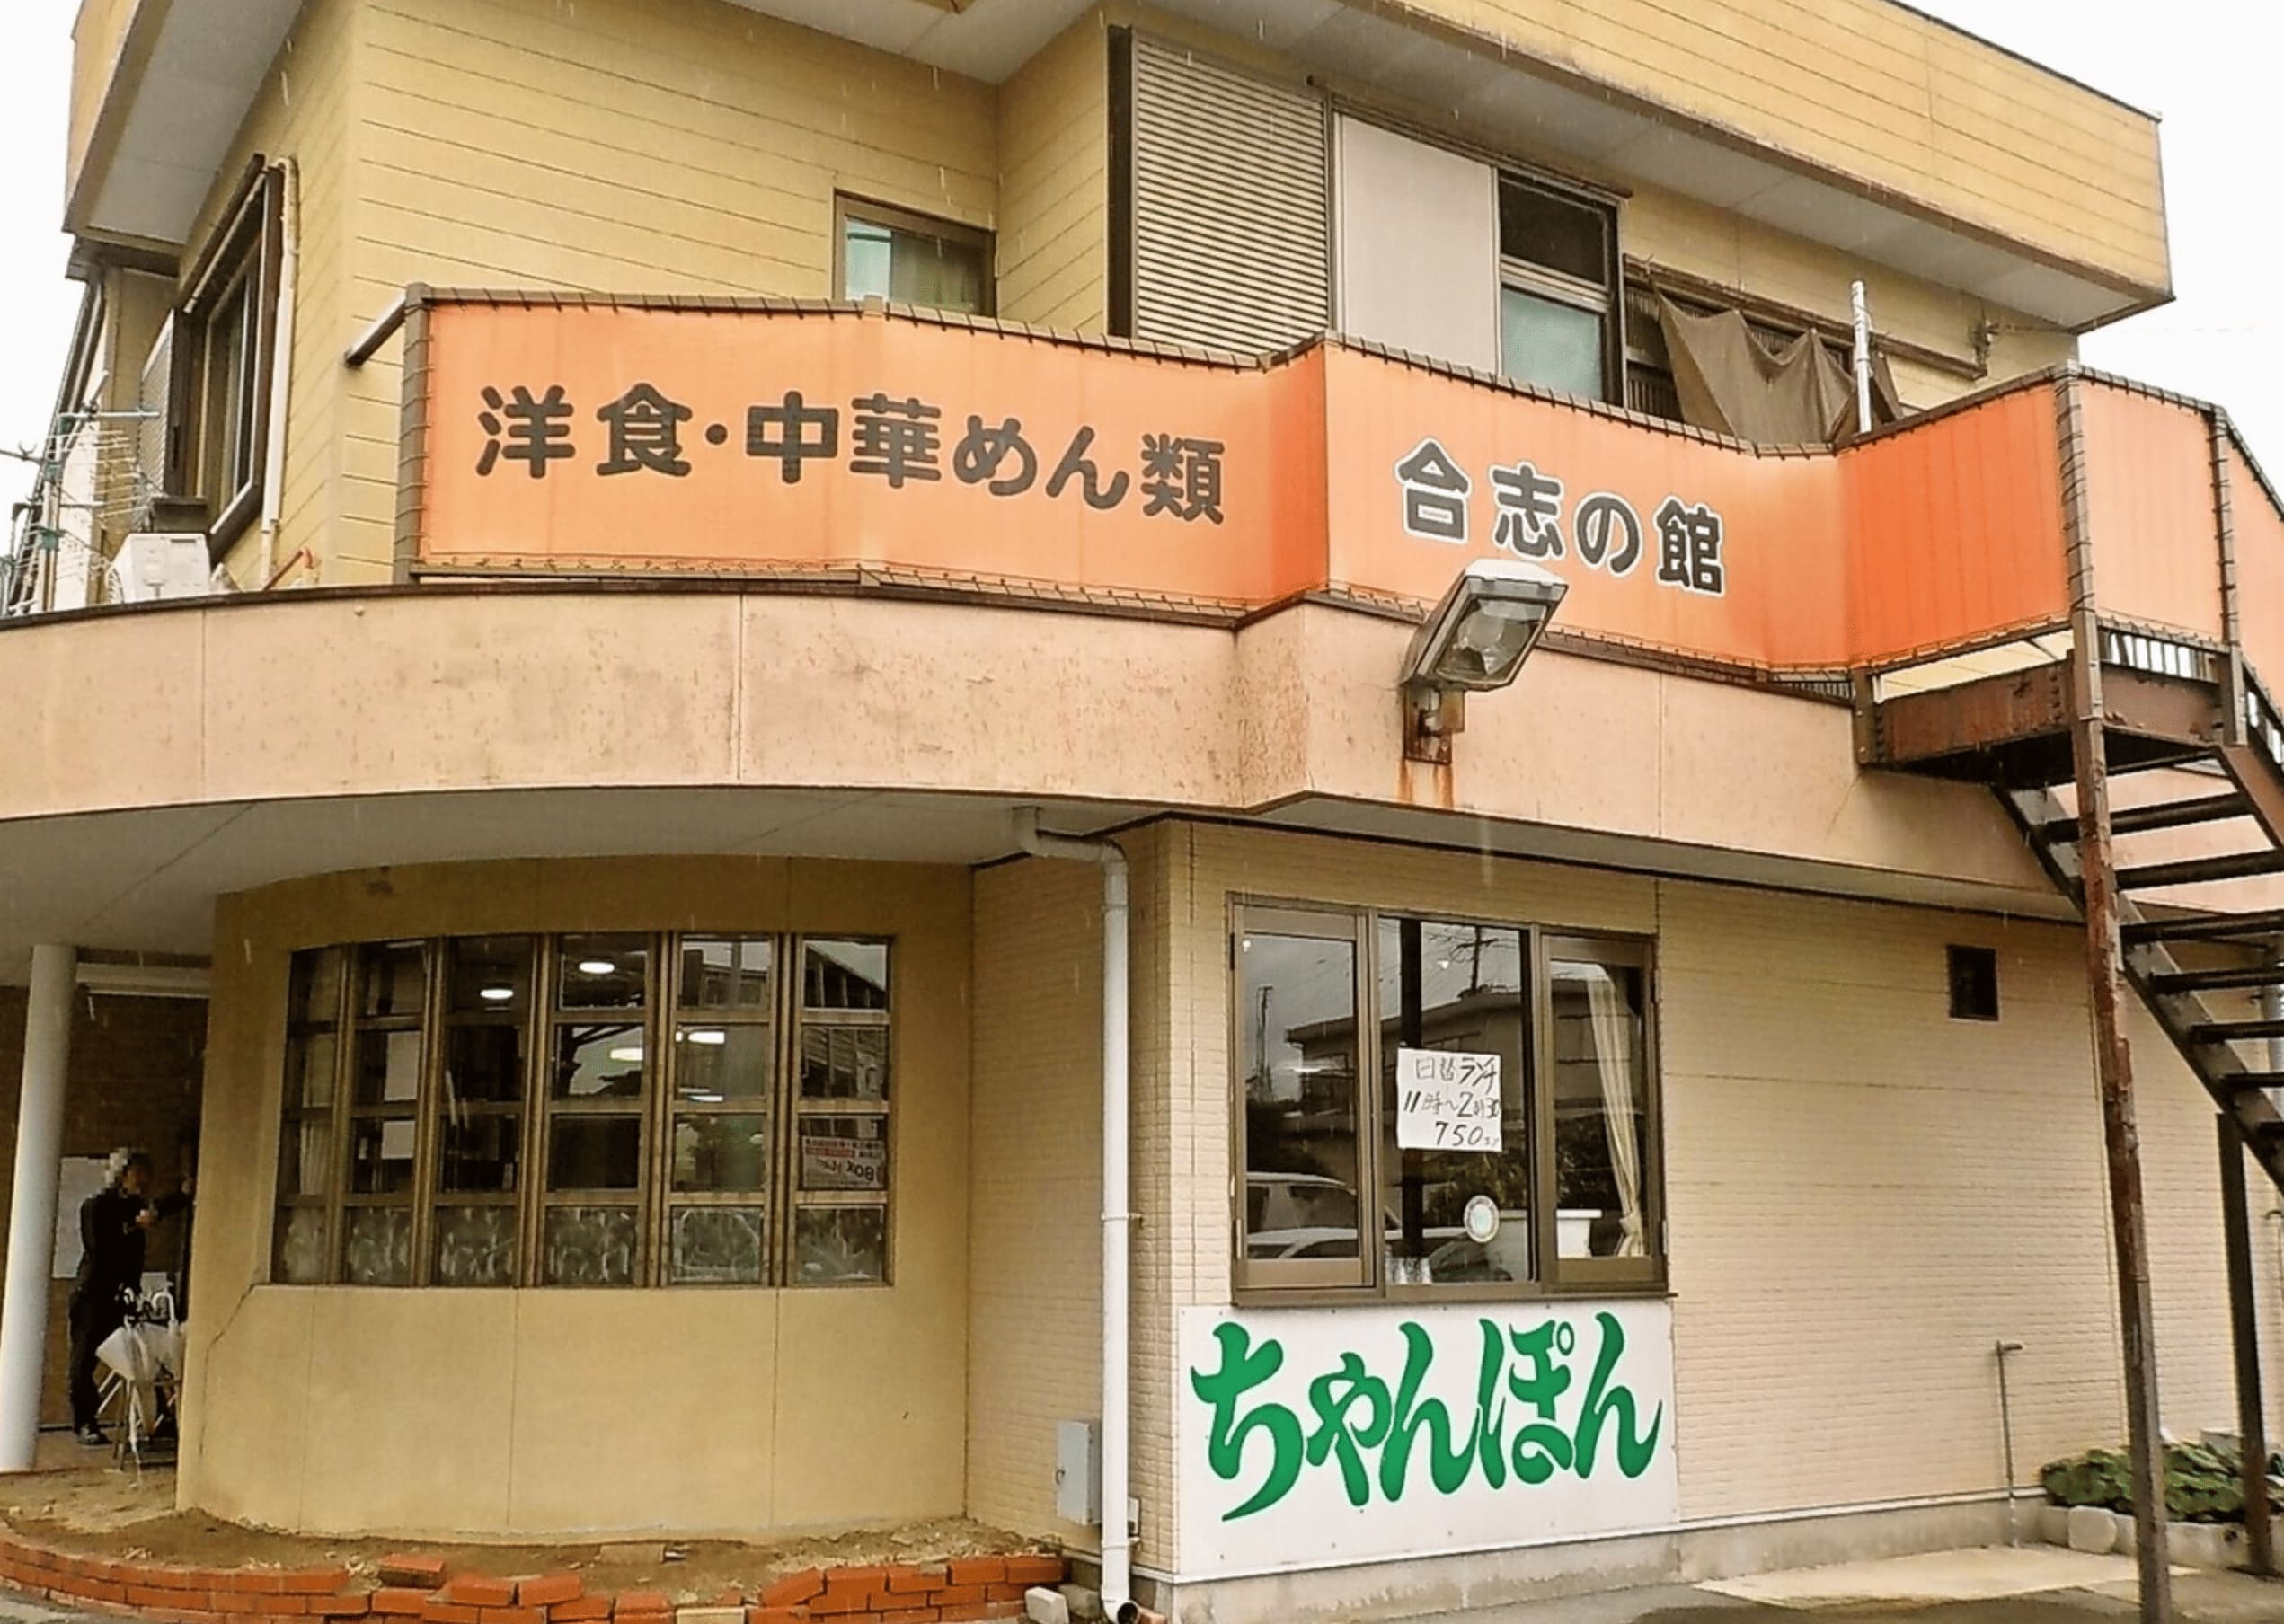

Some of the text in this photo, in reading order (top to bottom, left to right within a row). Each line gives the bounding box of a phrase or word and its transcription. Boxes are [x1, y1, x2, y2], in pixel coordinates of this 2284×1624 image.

[474, 382, 1225, 525] 洋食・中華めん類
[1394, 437, 1724, 596] 合志の館
[1190, 1311, 1662, 1521] ちゃんぽん
